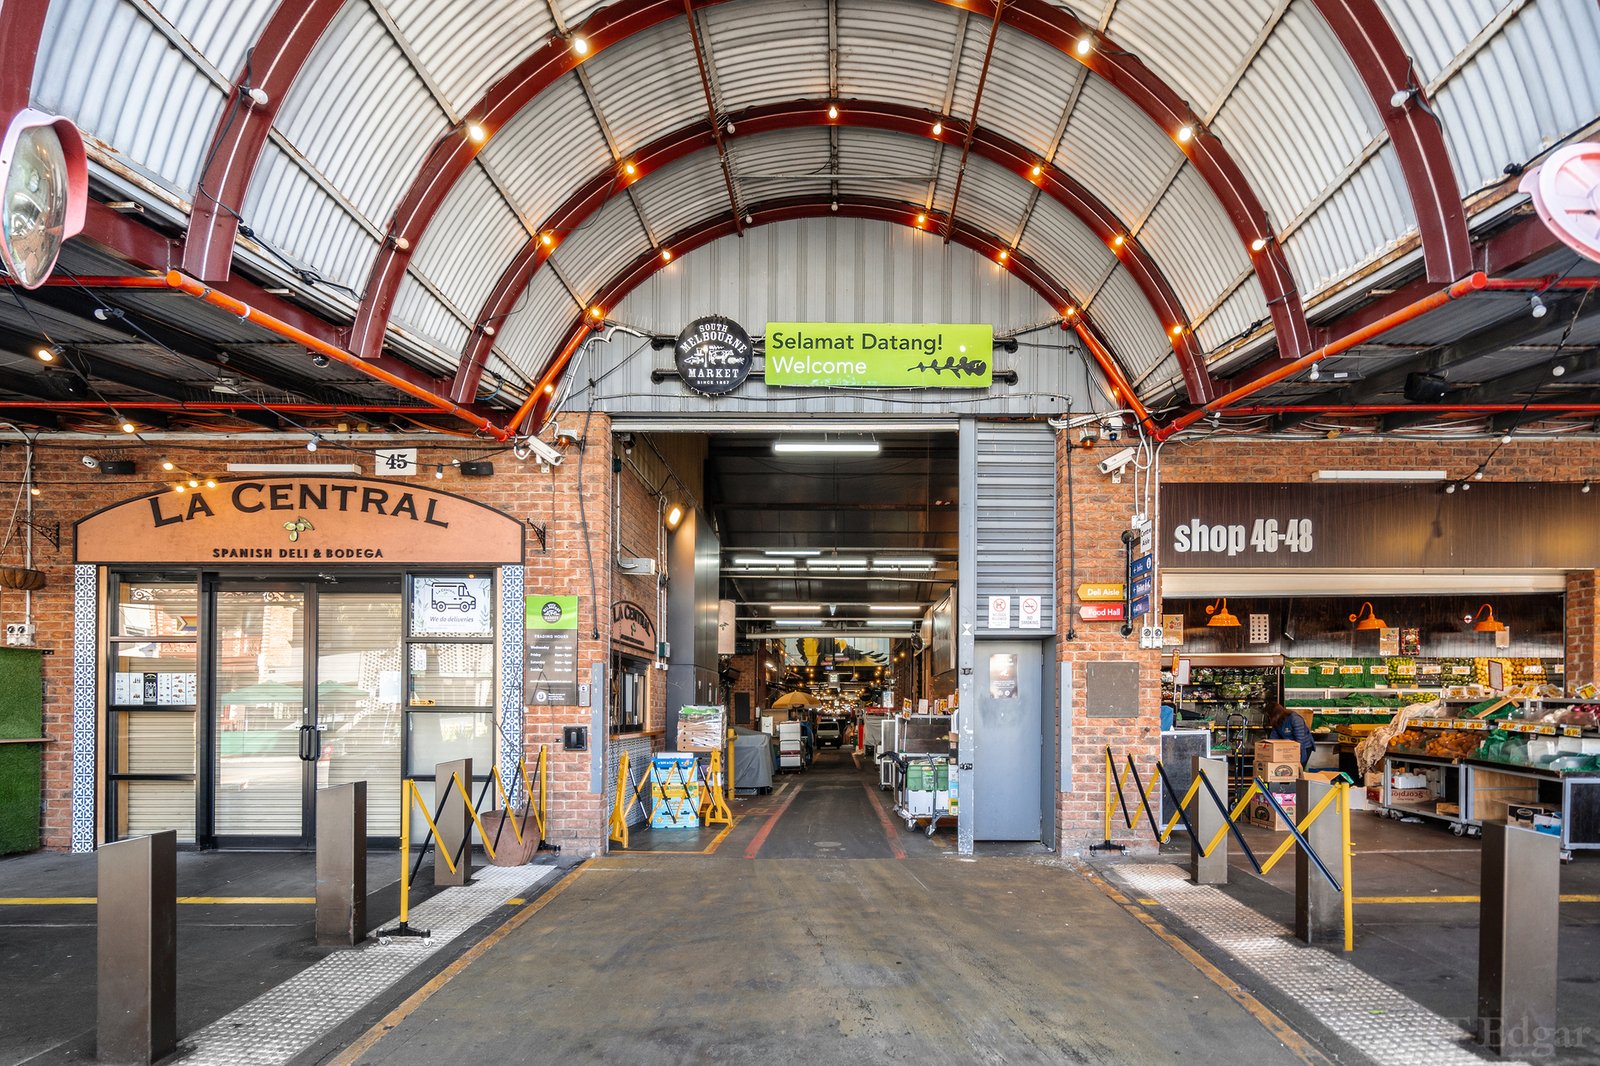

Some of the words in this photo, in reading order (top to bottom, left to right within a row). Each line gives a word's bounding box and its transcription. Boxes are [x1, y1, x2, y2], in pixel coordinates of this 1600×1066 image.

[699, 323, 729, 332] SOUTH
[679, 331, 748, 354] MELBOURNE
[772, 332, 854, 350] Selamat
[862, 333, 943, 355] Datang!
[688, 368, 739, 378] MARKET
[772, 355, 867, 374] Welcome
[385, 453, 408, 470] 45
[147, 492, 215, 528] LA
[231, 482, 449, 529] CENTRAL
[1173, 518, 1246, 556] shop
[1250, 518, 1313, 553] 46-48
[212, 548, 273, 558] SPANISH
[279, 548, 308, 558] DELI
[313, 549, 322, 559] &
[325, 549, 384, 559] BODEGA
[1087, 588, 1102, 596] Deli
[1102, 588, 1120, 596] Aisle
[613, 606, 623, 623] LA
[1088, 608, 1107, 616] Food
[1107, 608, 1121, 616] Hall
